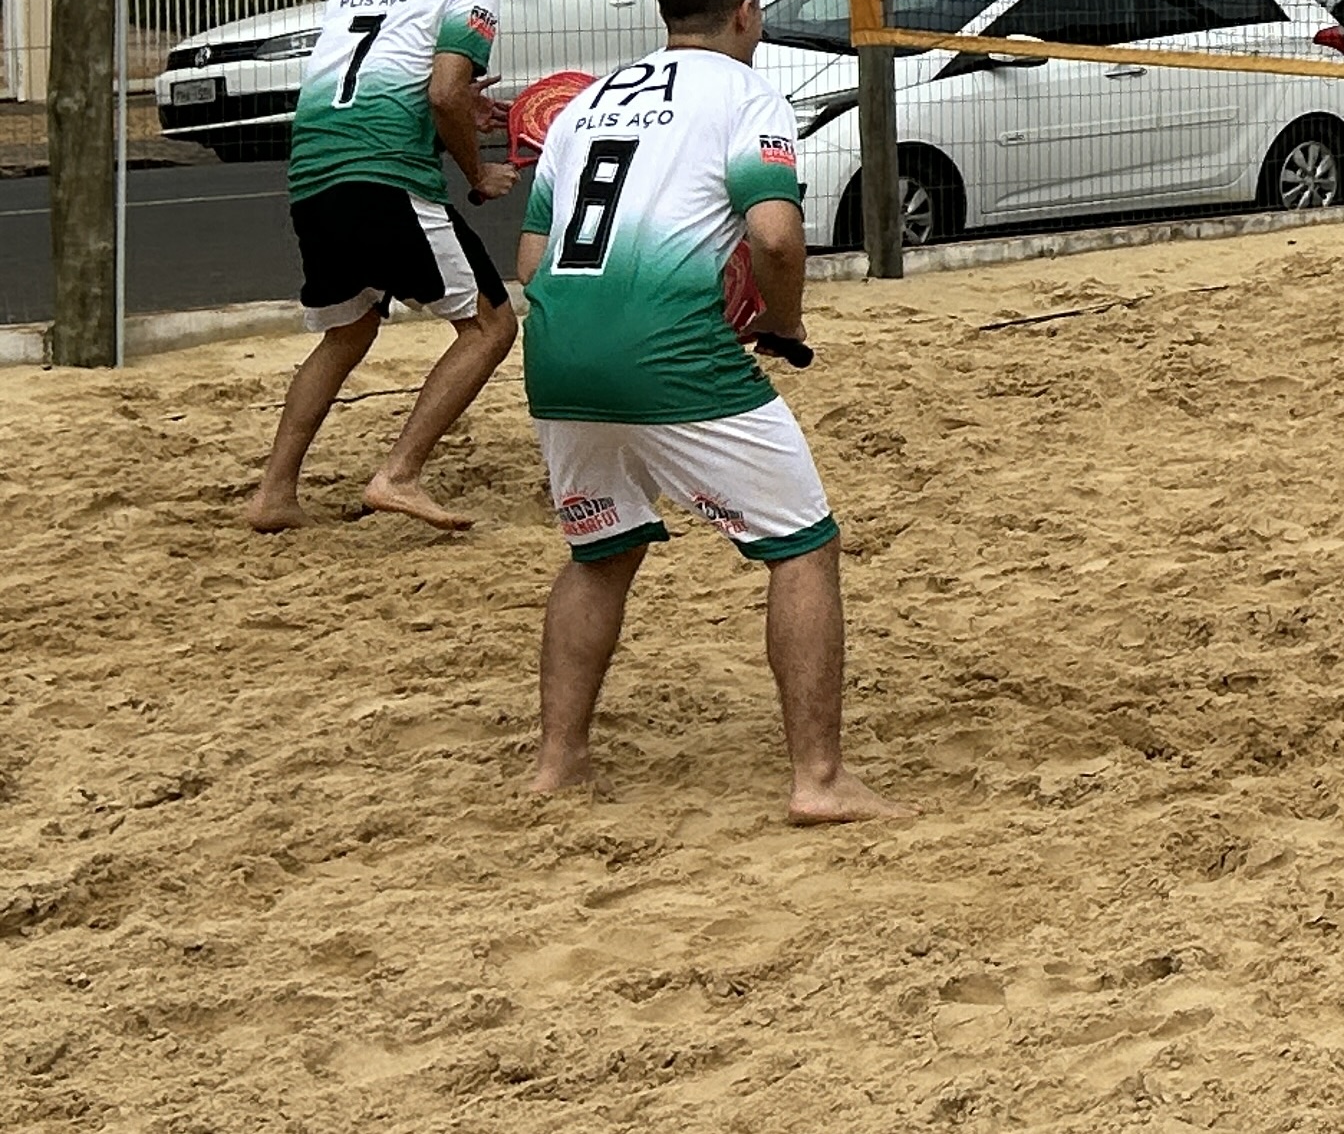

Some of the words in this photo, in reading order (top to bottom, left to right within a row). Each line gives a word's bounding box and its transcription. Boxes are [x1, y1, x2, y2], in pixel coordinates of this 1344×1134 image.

[333, 13, 387, 108] 7
[574, 112, 621, 134] PLIS
[626, 109, 674, 129] AÇO
[551, 135, 640, 274] 8
